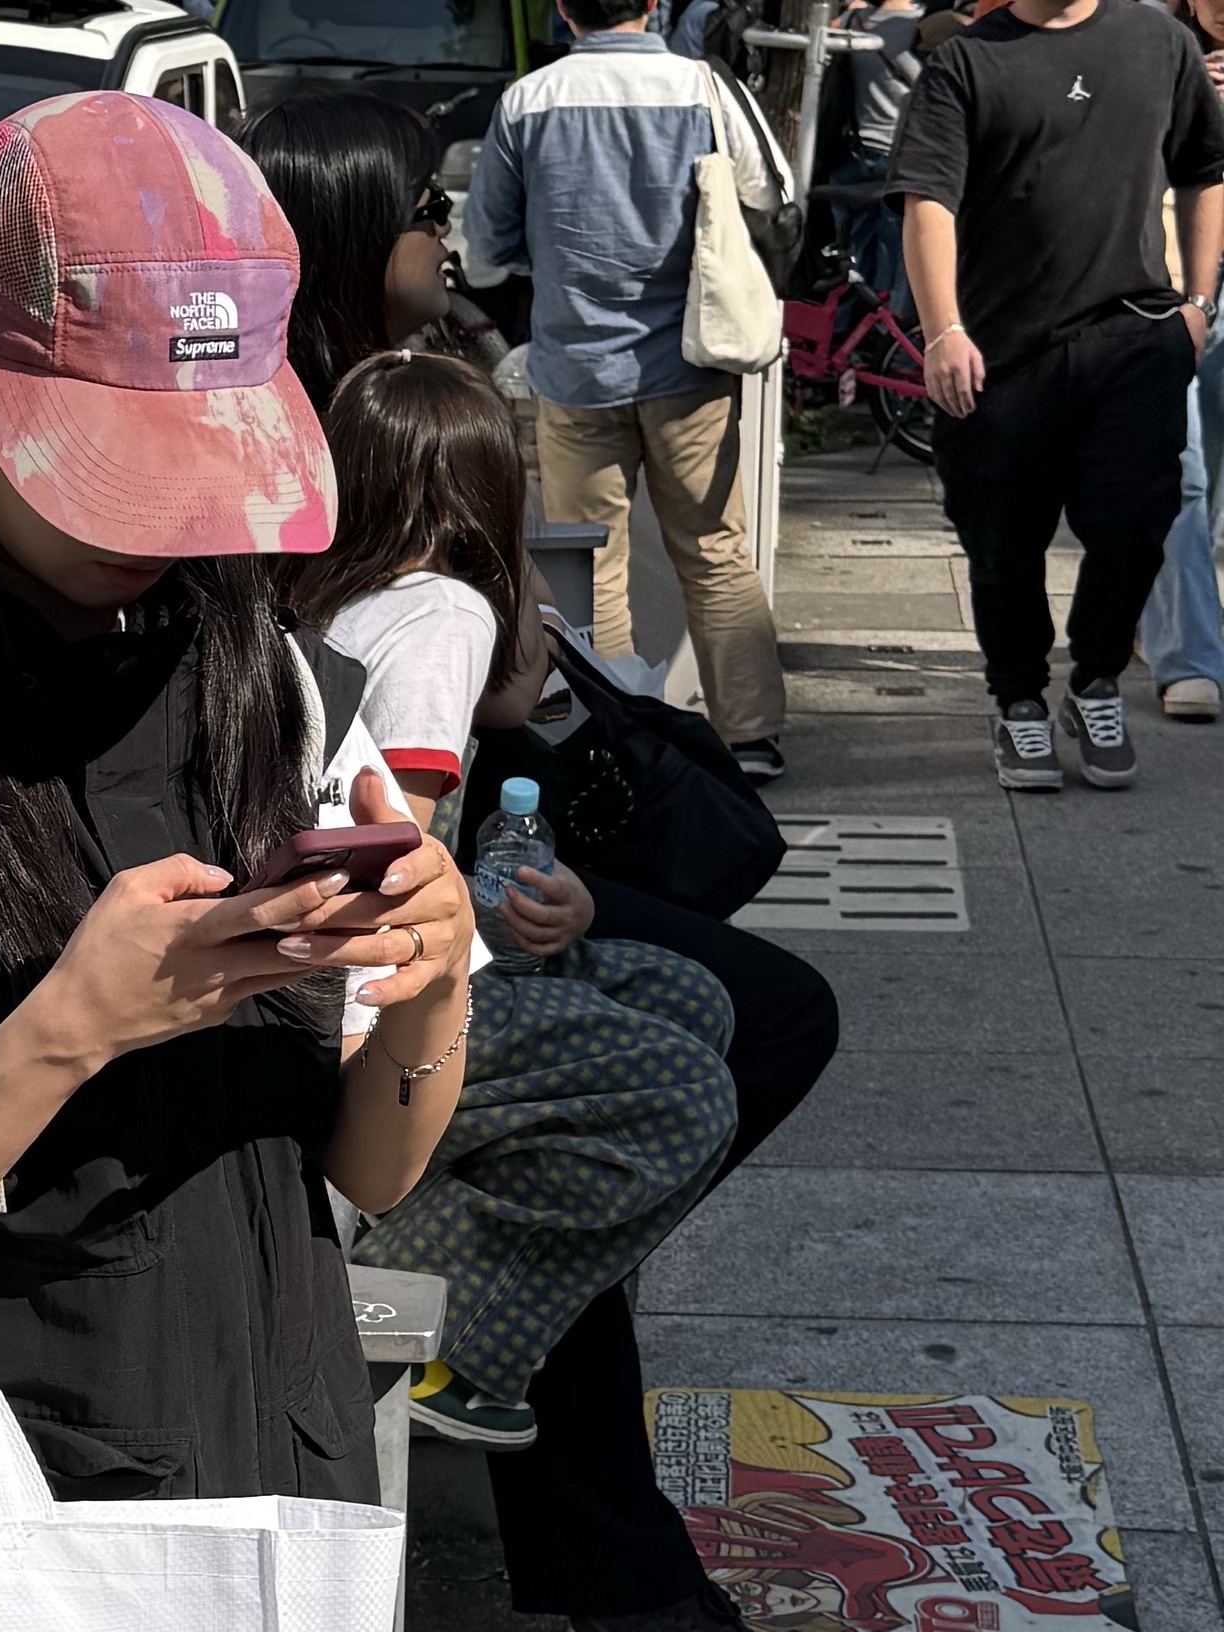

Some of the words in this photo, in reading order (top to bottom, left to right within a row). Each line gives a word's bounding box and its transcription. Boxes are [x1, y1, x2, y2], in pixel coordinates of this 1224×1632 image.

[189, 292, 215, 305] THE
[170, 305, 215, 318] NORTH
[183, 317, 215, 331] FACE
[175, 338, 236, 358] Supreme
